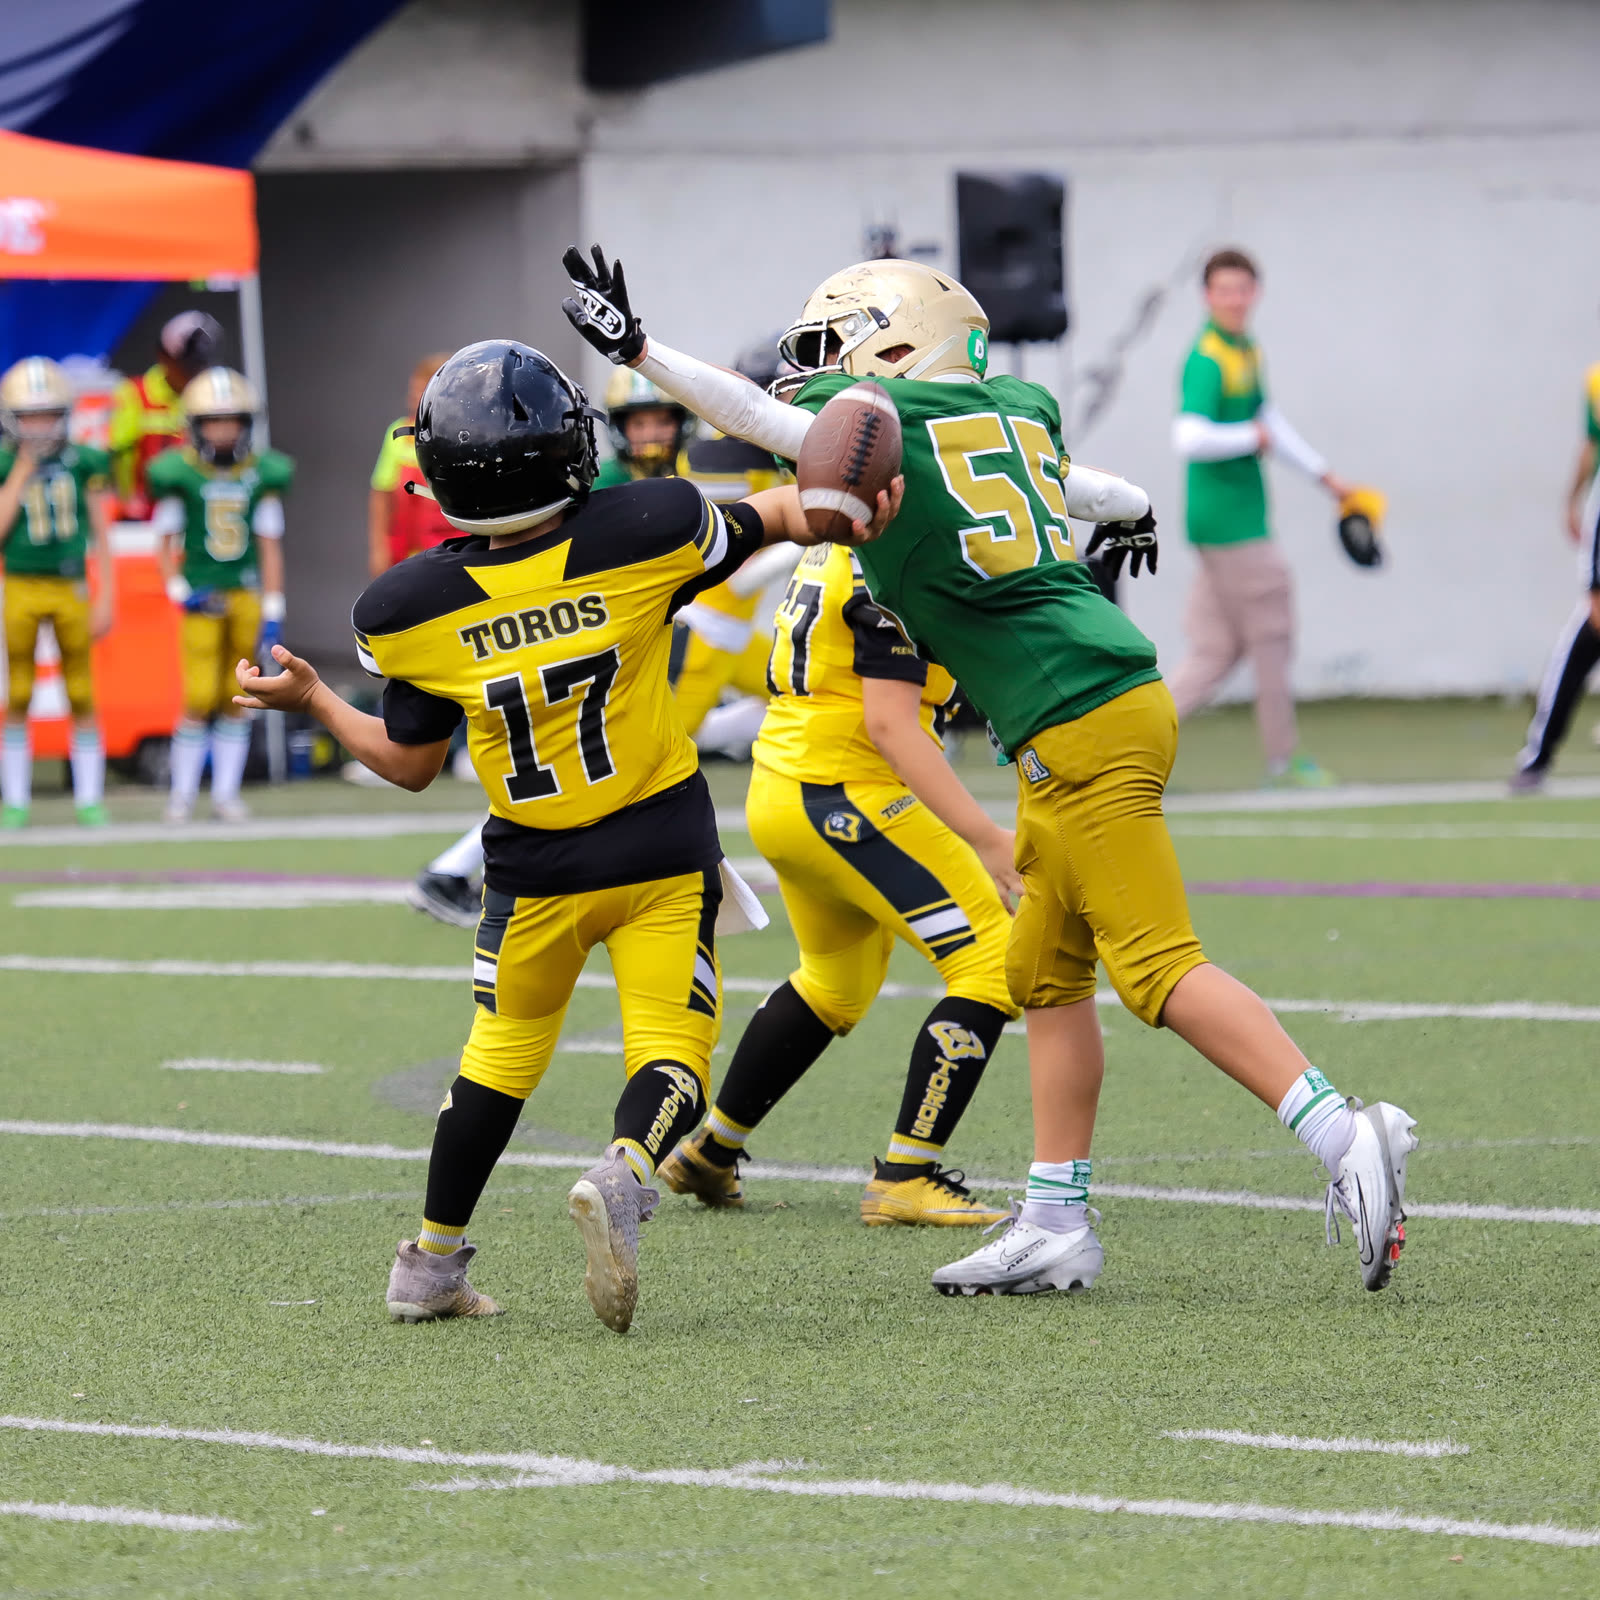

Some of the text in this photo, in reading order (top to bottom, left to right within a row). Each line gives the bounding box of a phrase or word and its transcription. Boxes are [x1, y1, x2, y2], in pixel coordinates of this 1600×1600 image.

[204, 498, 249, 562] 5
[925, 412, 1078, 580] 55
[457, 592, 609, 662] TOROS
[483, 643, 622, 804] 17
[643, 1083, 686, 1155] TOROS
[909, 1055, 959, 1139] TOROS
